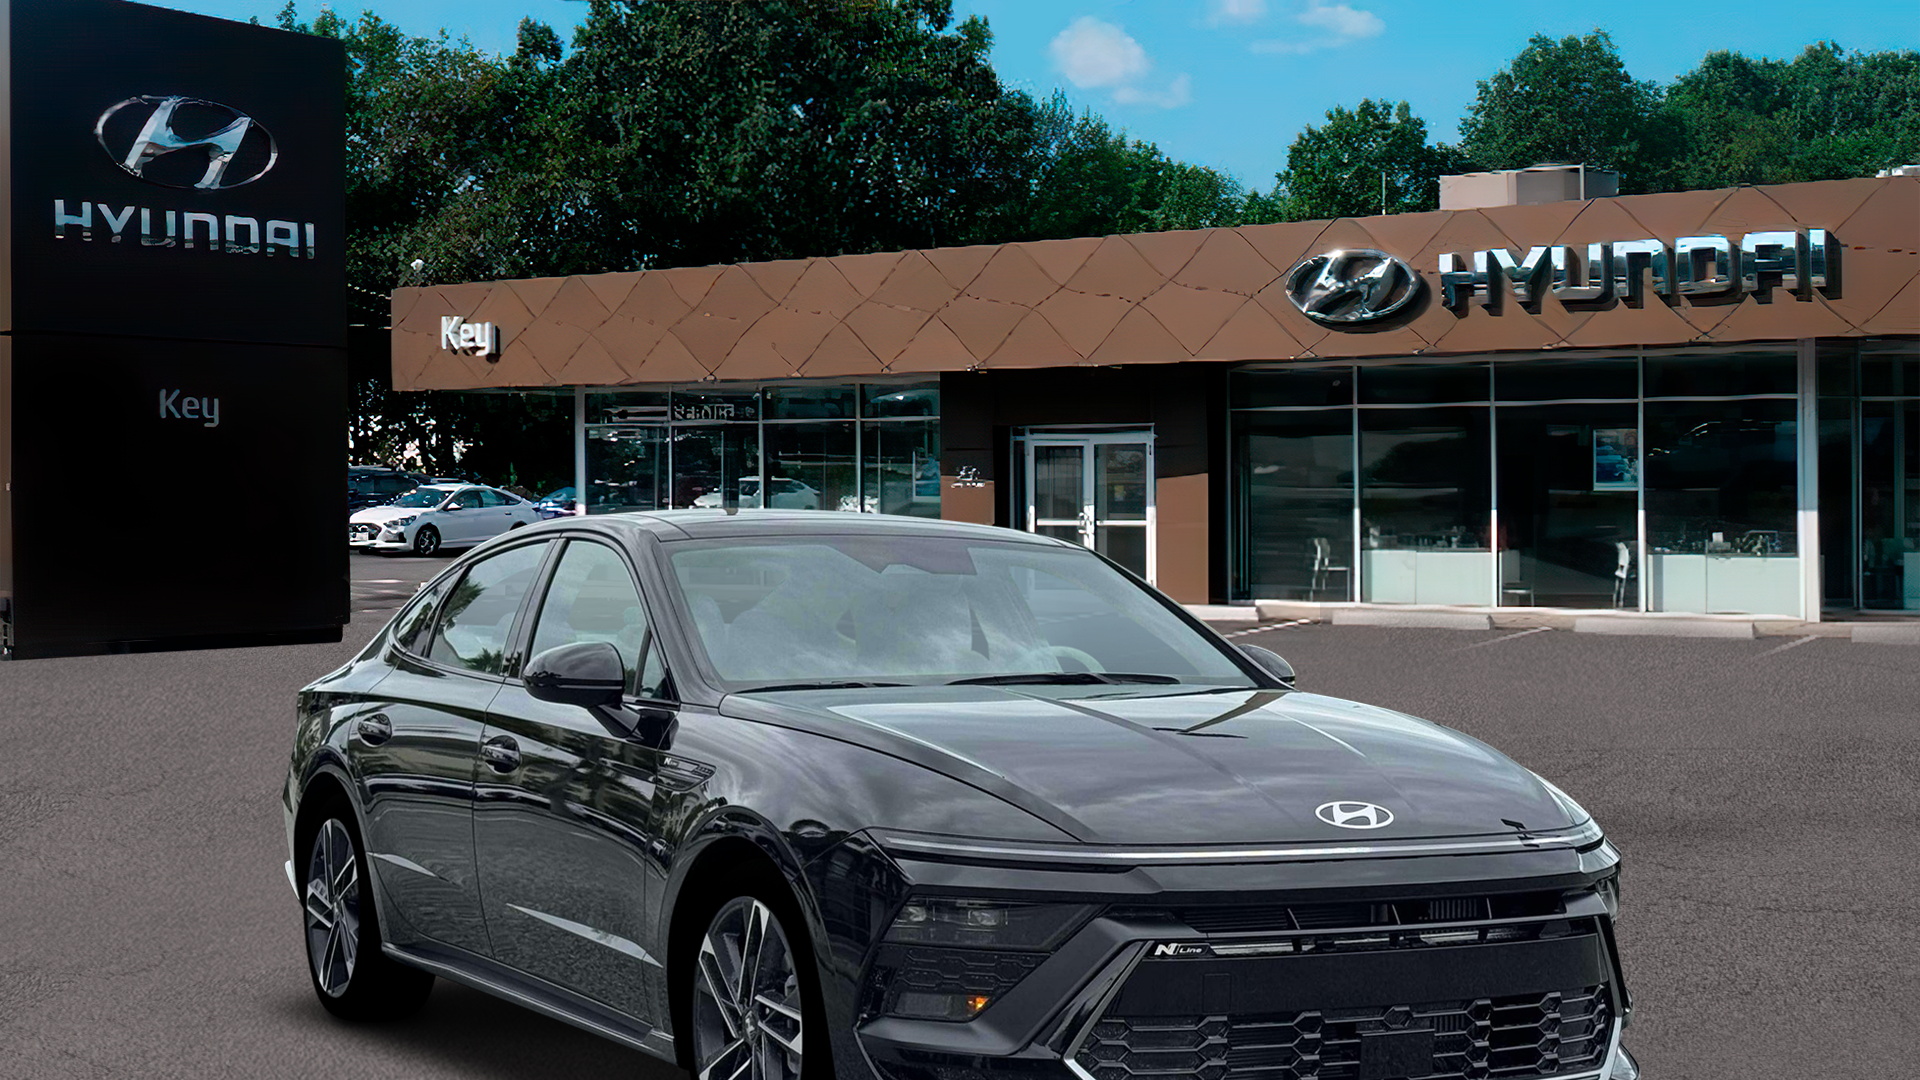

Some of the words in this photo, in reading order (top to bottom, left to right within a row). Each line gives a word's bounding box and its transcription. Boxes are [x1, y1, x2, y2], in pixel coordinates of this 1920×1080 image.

[54, 199, 315, 260] HYUNDAI
[1438, 228, 1836, 312] HYUNDAI
[441, 315, 492, 357] Key
[159, 388, 220, 428] Key
[1154, 943, 1179, 956] N
